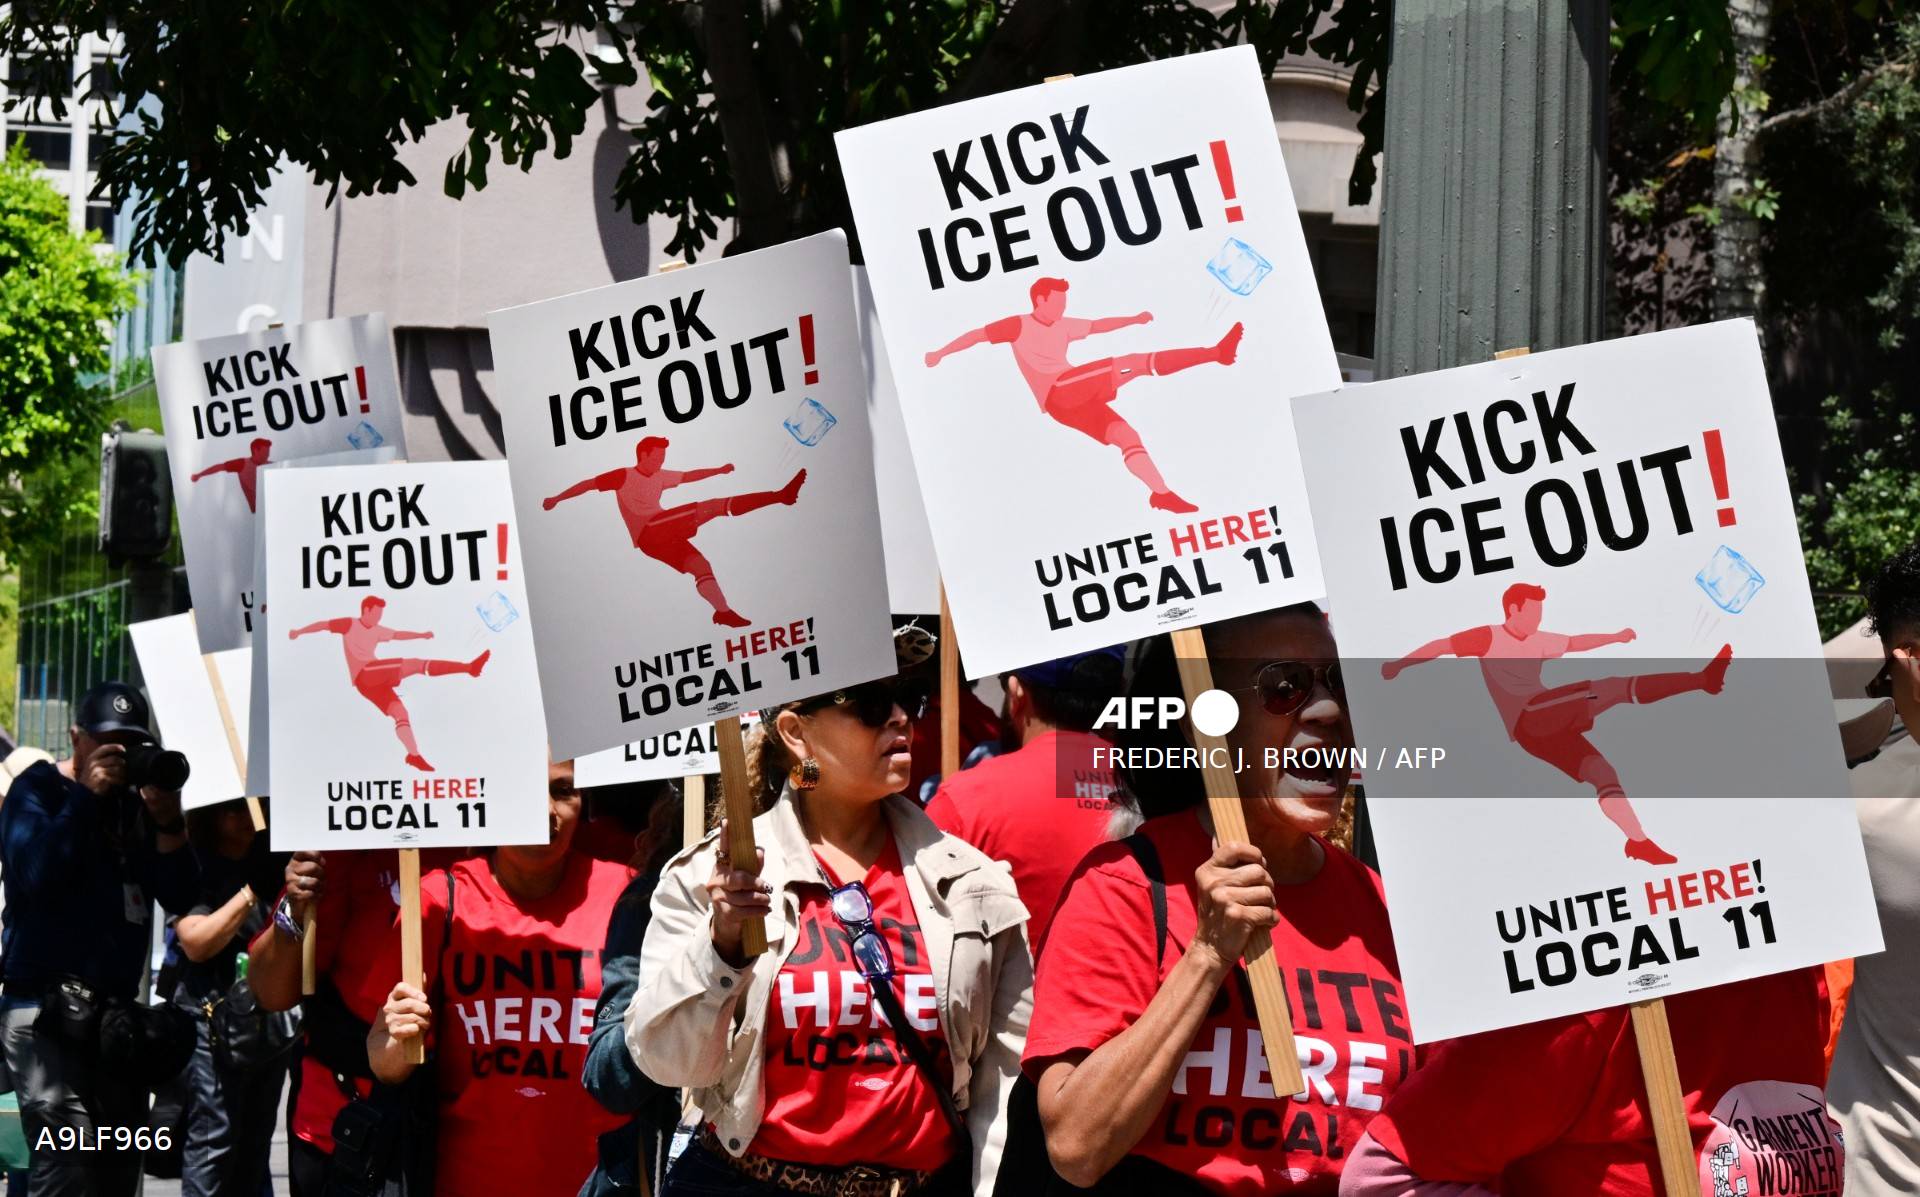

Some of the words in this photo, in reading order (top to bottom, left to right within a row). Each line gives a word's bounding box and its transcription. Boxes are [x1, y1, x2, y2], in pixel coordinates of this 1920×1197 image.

[932, 104, 1111, 212] KICK
[917, 205, 1040, 291] ICE
[1046, 139, 1246, 263] OUT!
[203, 342, 300, 397] KICK
[568, 288, 717, 381] KICK
[192, 396, 257, 440] ICE
[262, 365, 371, 432] OUT!
[548, 375, 648, 448] ICE
[656, 313, 820, 424] OUT!
[1399, 382, 1597, 500] KICK
[321, 483, 430, 539] KICK
[1034, 532, 1159, 588] UNITE
[1168, 505, 1283, 558] HERE!
[1379, 496, 1515, 591] ICE
[1523, 428, 1738, 568] OUT!
[302, 544, 372, 589] ICE
[382, 522, 509, 590] OUT!
[1042, 557, 1223, 631] LOCAL
[1242, 541, 1295, 586] 11
[614, 643, 715, 689] UNITE
[724, 616, 816, 663] HERE!
[617, 661, 763, 724] LOCAL
[780, 644, 821, 682] 11
[624, 726, 719, 762] LOCAL
[327, 780, 403, 802] UNITE
[412, 777, 485, 800] HERE!
[328, 802, 439, 831] LOCAL
[456, 802, 486, 828] 11
[1495, 886, 1632, 945] UNITE
[1644, 858, 1767, 916] HERE!
[453, 948, 603, 996] UNIT
[1502, 917, 1700, 994] LOCAL
[1722, 900, 1777, 951] 11
[455, 997, 598, 1046] HERE
[784, 1031, 913, 1071] LOCA
[1164, 1102, 1345, 1159] LOCAL
[1752, 1146, 1839, 1197] WORKER
